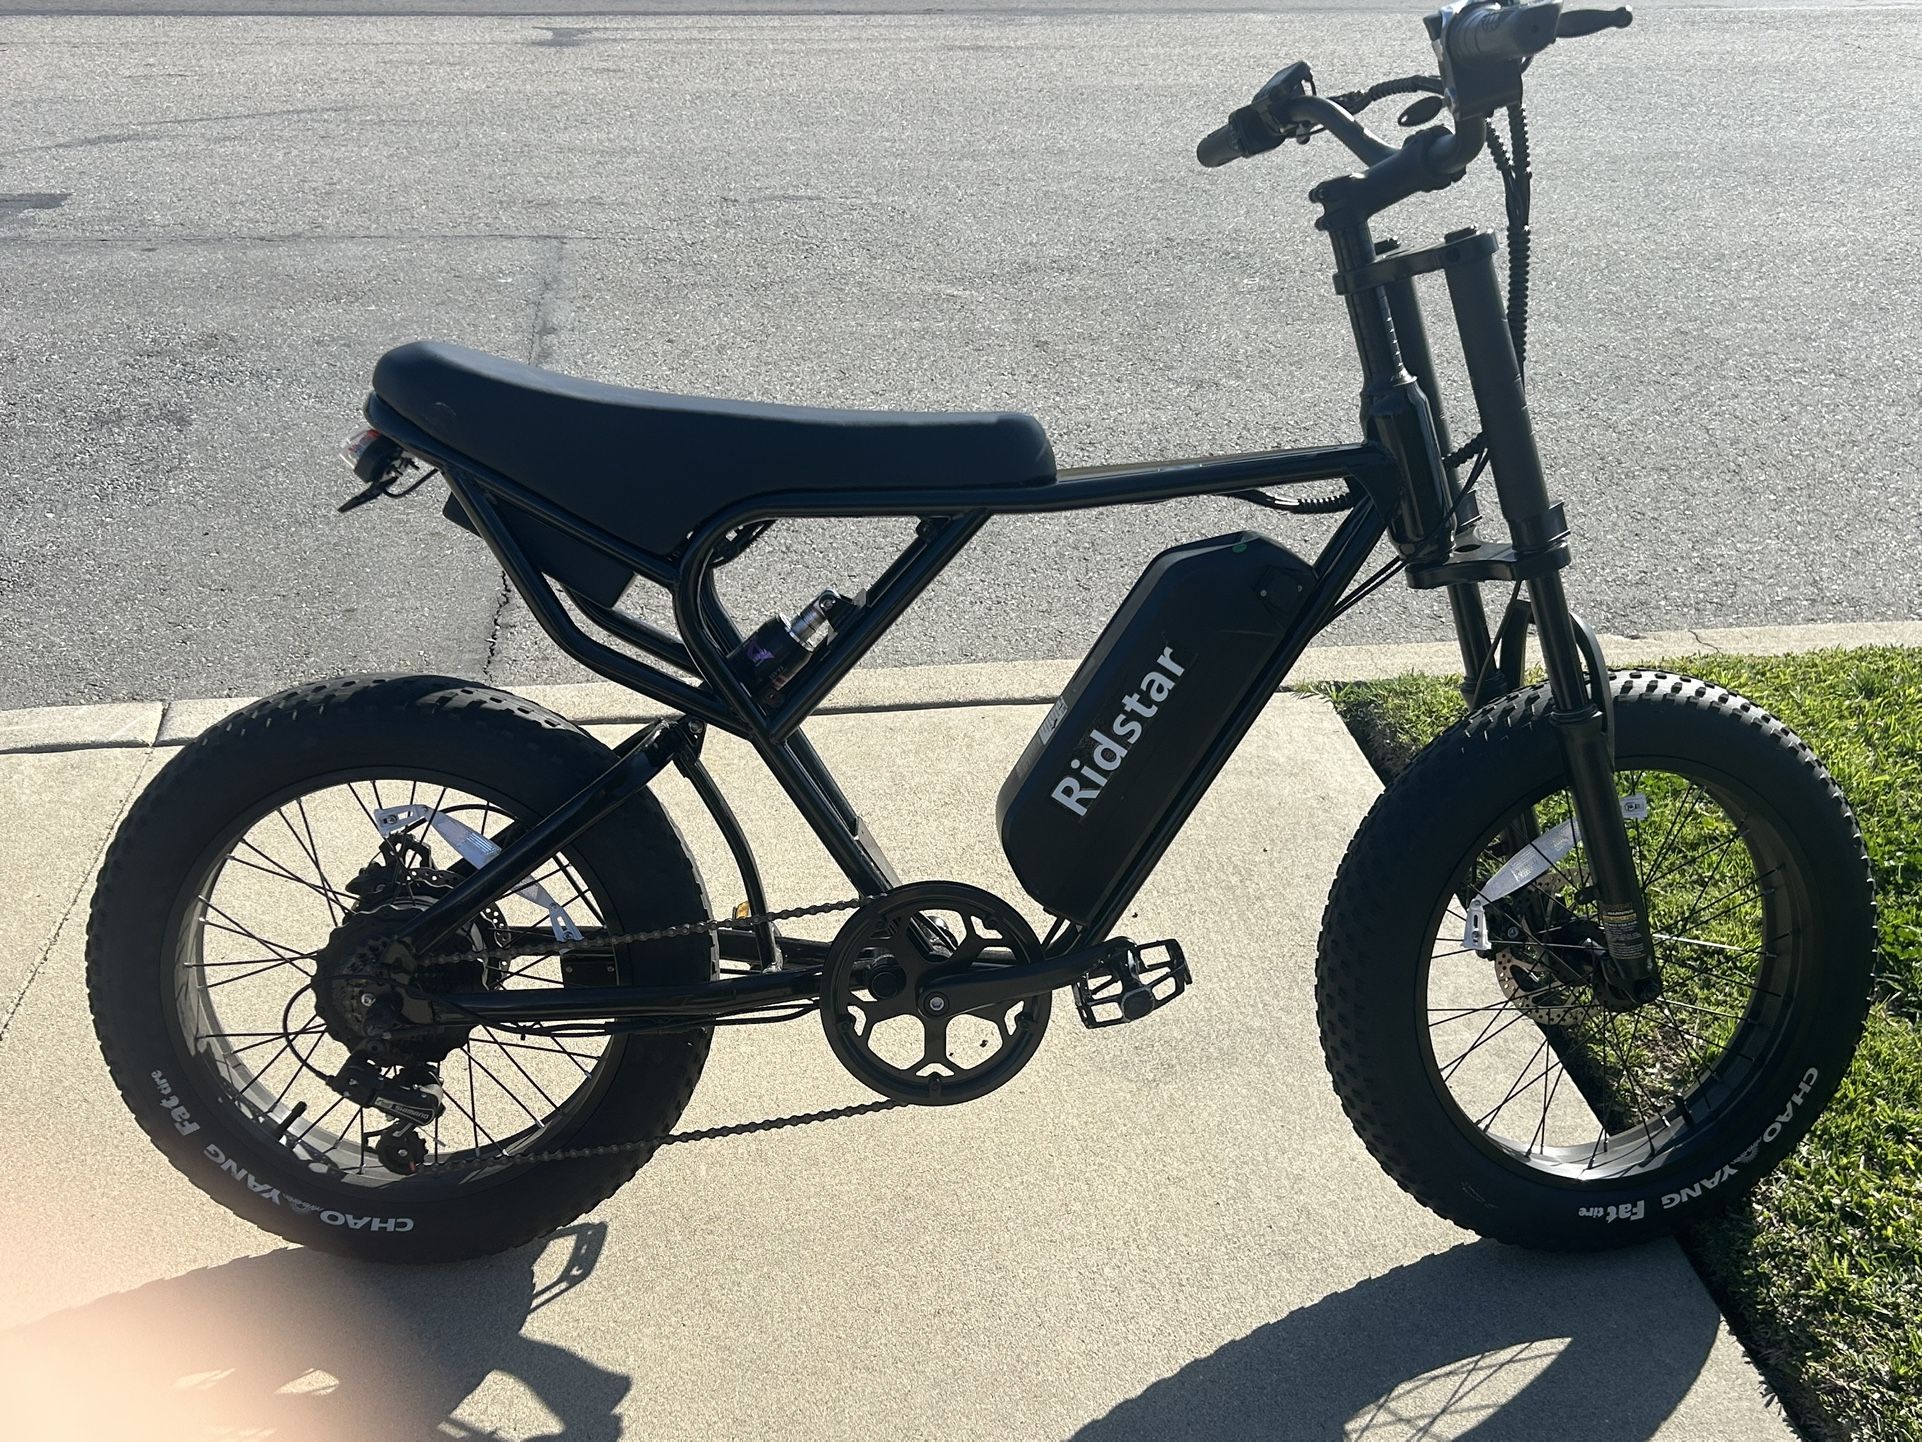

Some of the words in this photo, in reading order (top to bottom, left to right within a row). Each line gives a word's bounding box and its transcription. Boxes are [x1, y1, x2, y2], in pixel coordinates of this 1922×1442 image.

[1051, 647, 1185, 816] Ridstar
[151, 1070, 172, 1095] tire
[159, 1095, 201, 1137] Fat
[1763, 1067, 1819, 1143] CHAO
[203, 1144, 280, 1206] YANG
[1661, 1163, 1738, 1209] YANG
[320, 1210, 414, 1232] CHAO
[1578, 1207, 1604, 1219] tire
[1606, 1200, 1645, 1224] Fat
